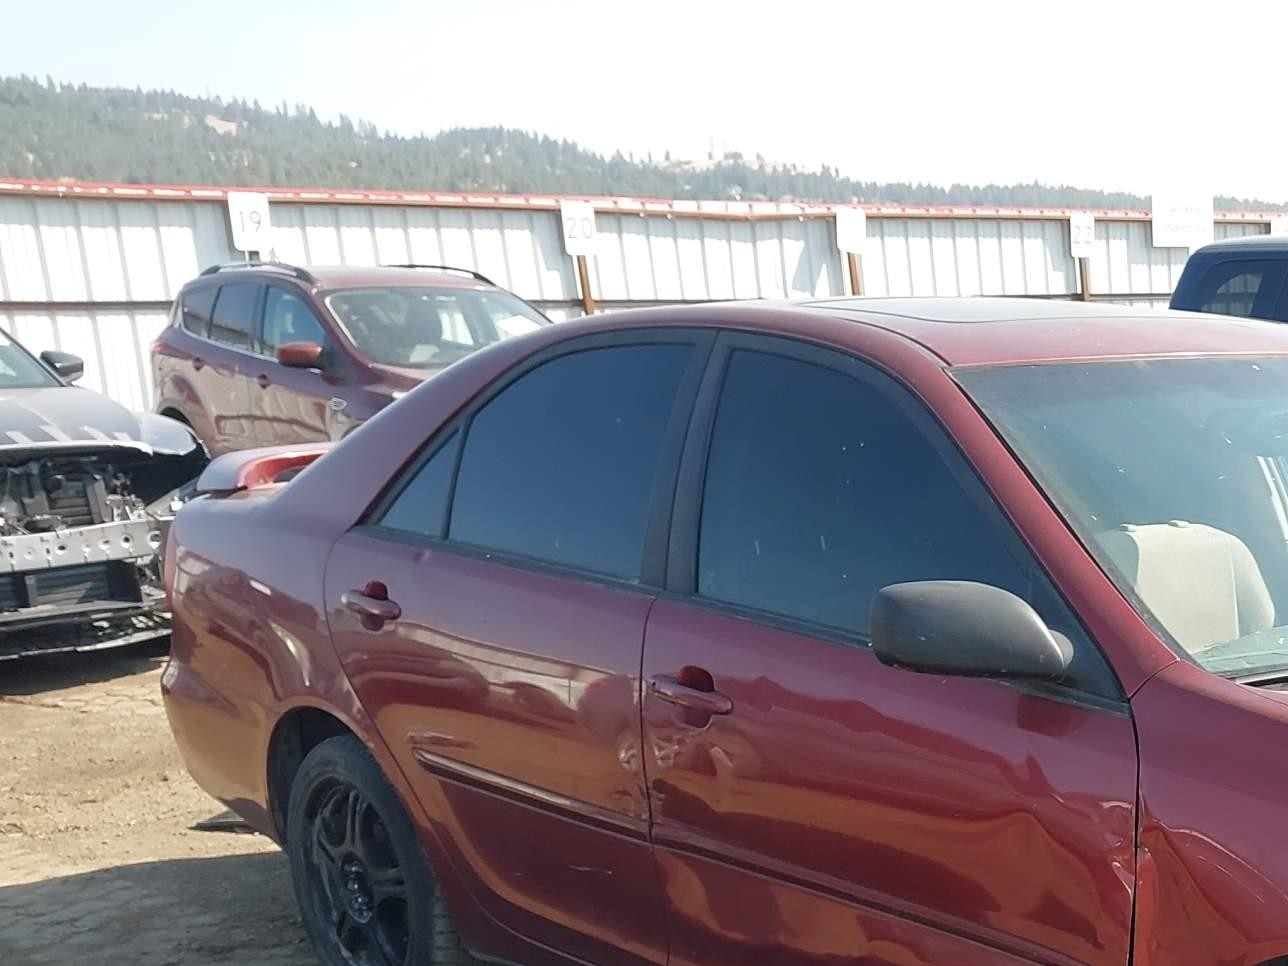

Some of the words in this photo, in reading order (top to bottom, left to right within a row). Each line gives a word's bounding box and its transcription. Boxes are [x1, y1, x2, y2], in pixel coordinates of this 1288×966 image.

[239, 211, 262, 233] 19
[566, 217, 593, 239] 20
[1073, 225, 1093, 244] 22
